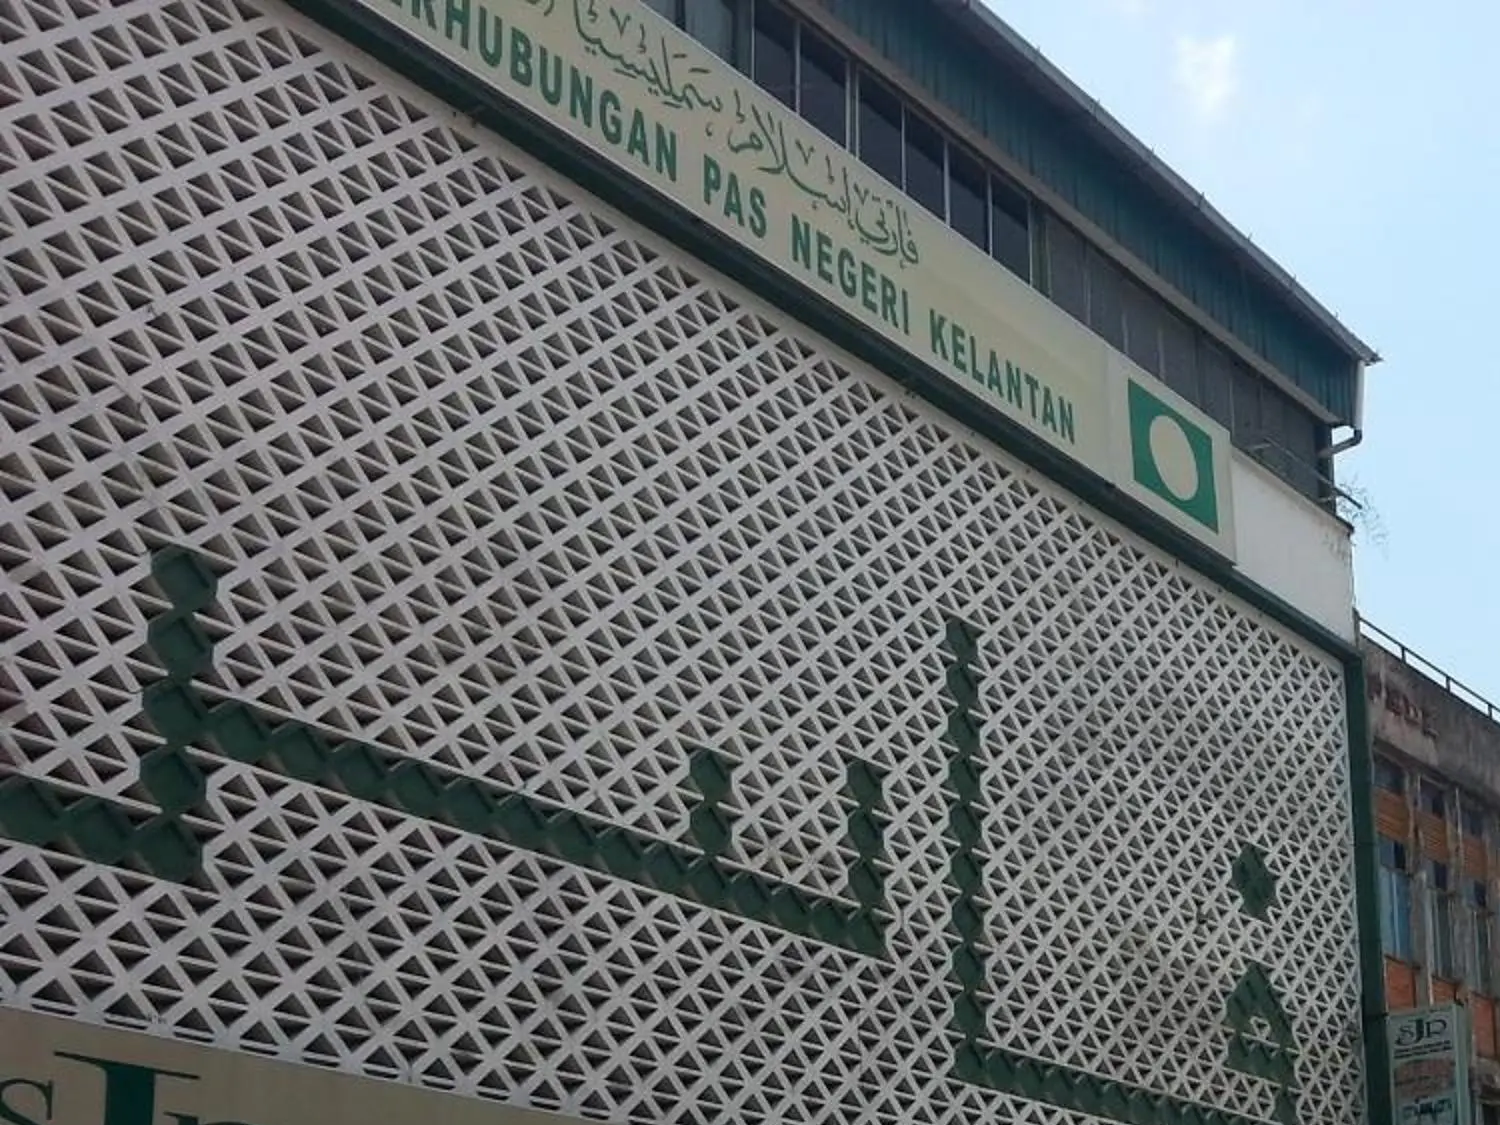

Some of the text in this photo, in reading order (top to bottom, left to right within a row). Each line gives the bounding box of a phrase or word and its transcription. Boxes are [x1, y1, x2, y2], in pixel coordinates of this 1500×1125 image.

[396, 0, 1076, 446] HUBUNGAN PAS NEGERI KELANTAN
